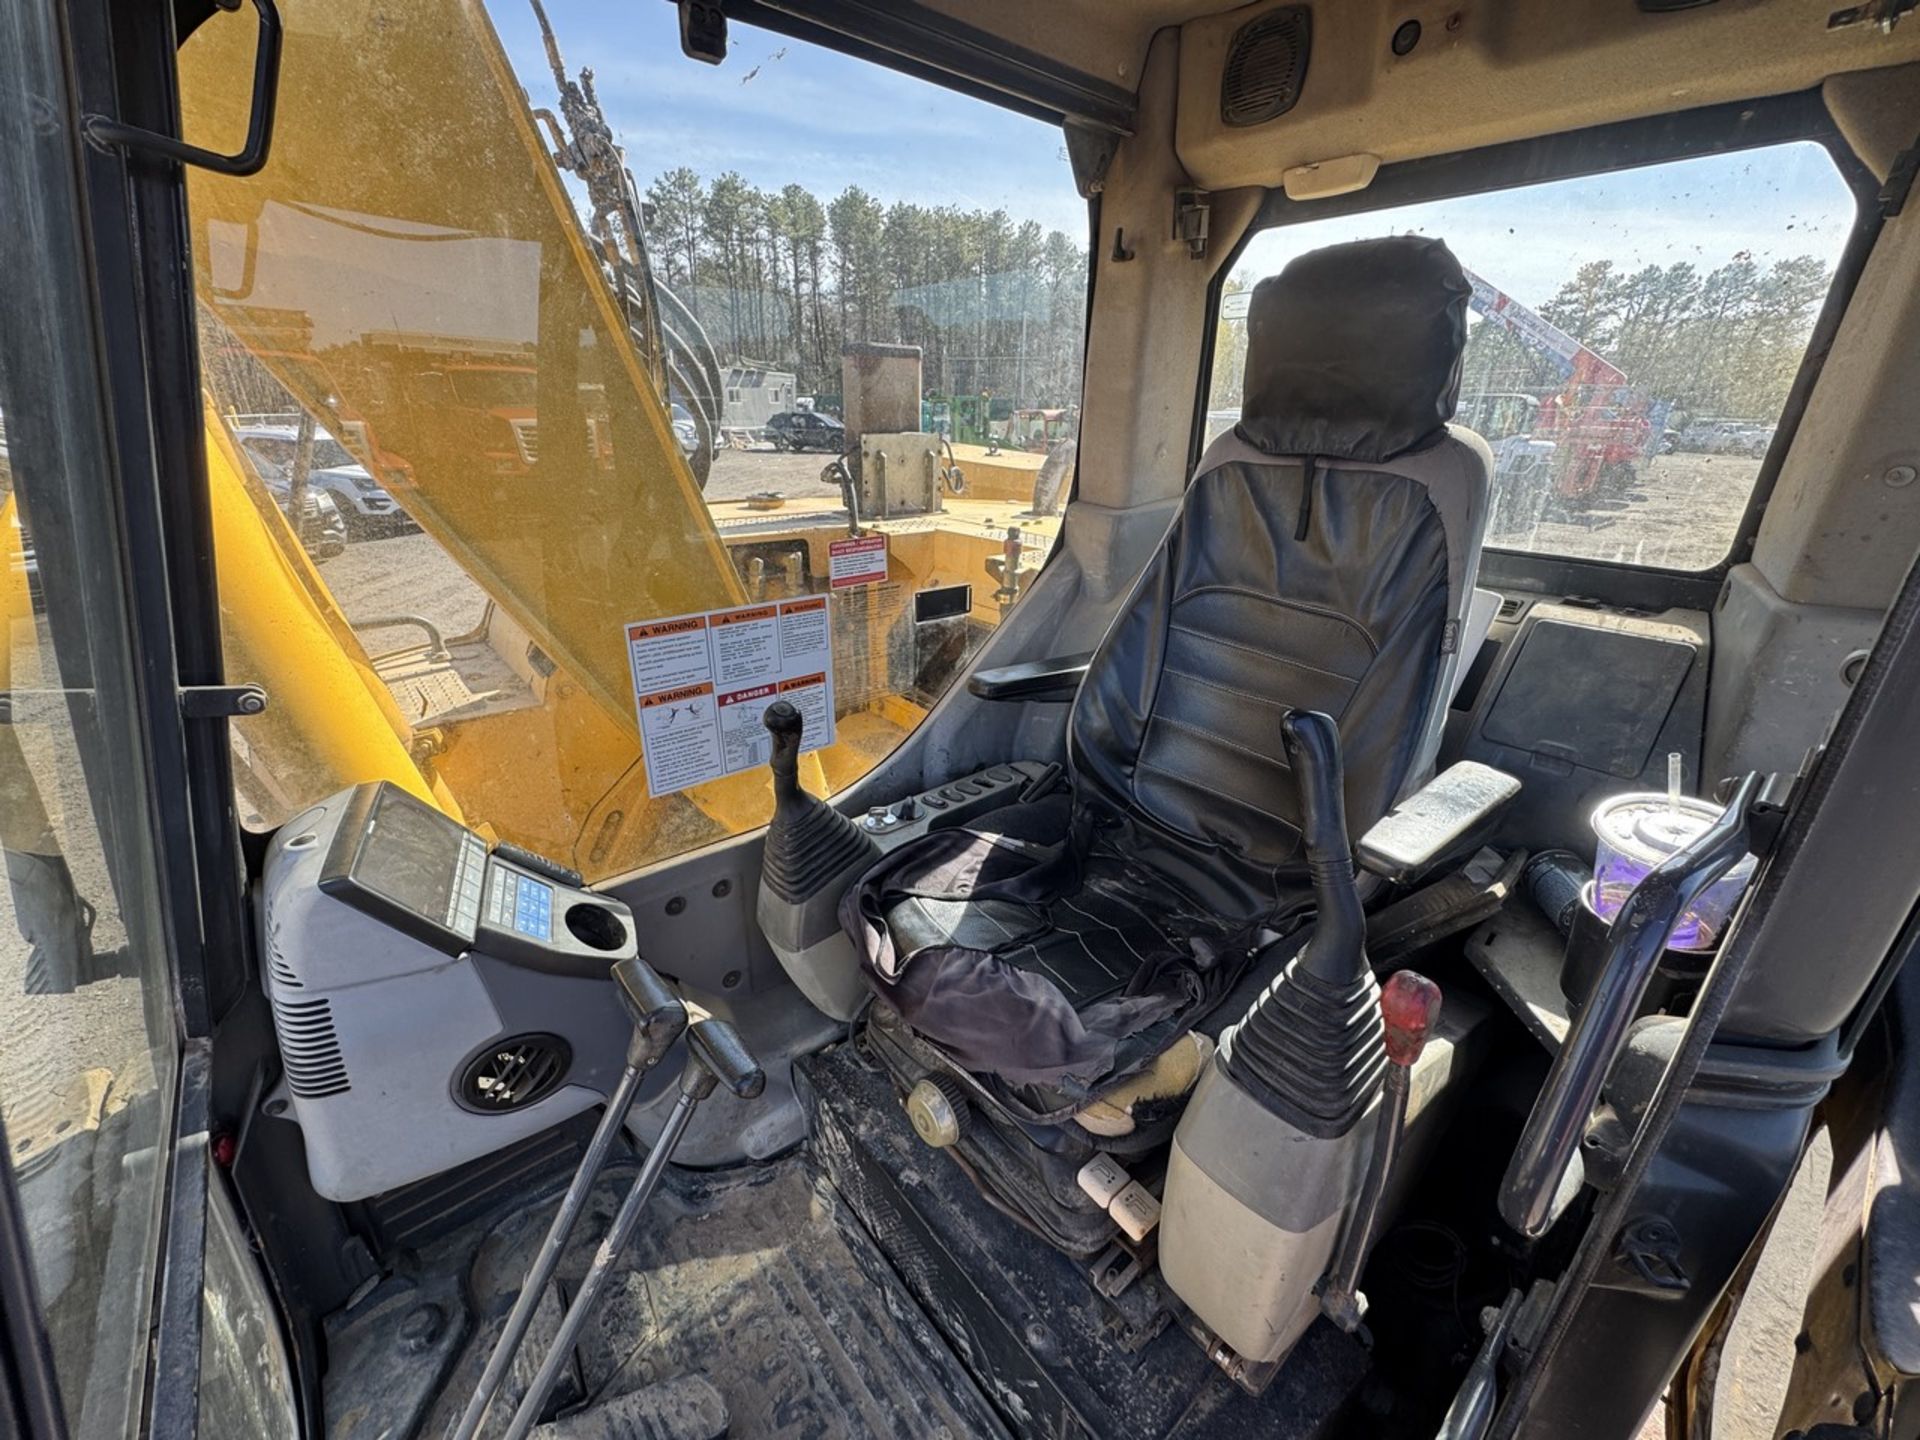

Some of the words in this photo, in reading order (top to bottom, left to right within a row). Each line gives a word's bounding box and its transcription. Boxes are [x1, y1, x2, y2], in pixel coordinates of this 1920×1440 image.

[794, 602, 820, 611] WARNING
[735, 610, 769, 620] WARNING
[652, 621, 698, 634] WARNING
[790, 676, 821, 688] WARNING
[658, 686, 703, 703] WARNING
[736, 687, 770, 701] DANGER
